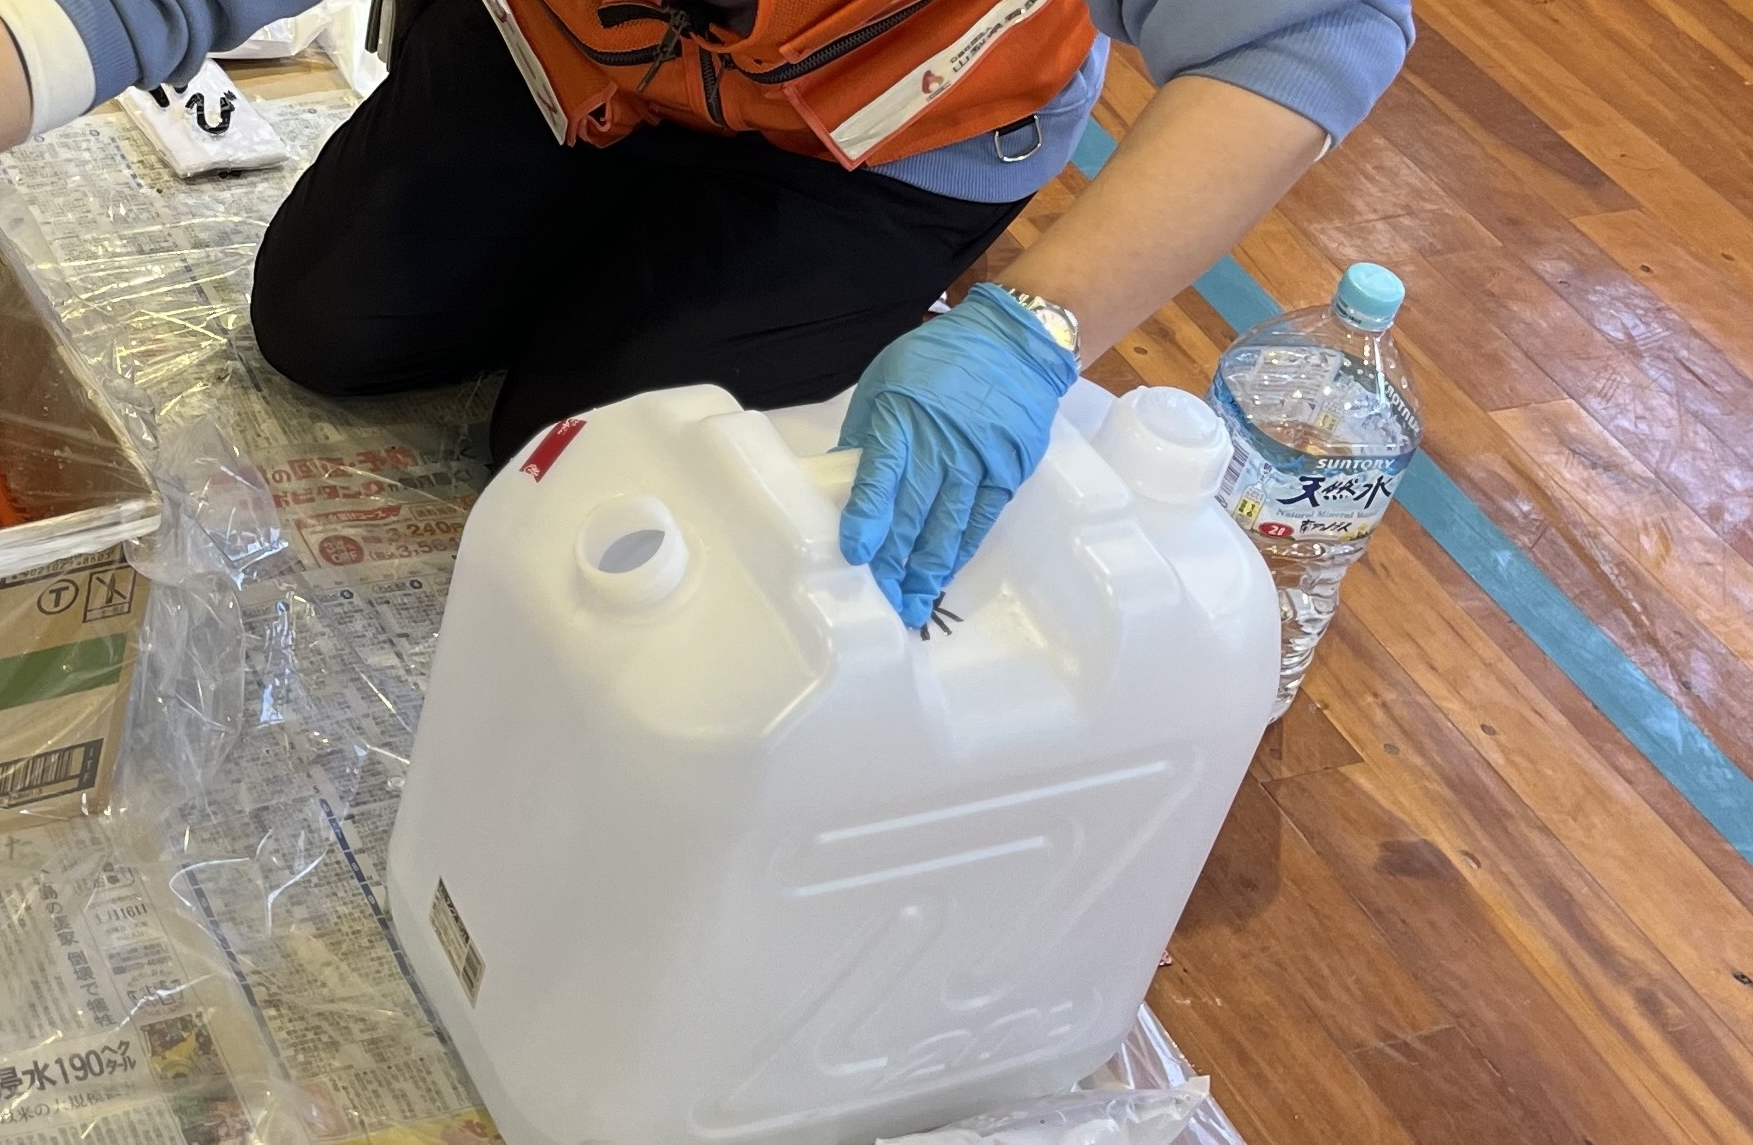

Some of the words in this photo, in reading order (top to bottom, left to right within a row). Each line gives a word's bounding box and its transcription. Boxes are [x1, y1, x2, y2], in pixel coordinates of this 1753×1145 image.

[1316, 458, 1395, 470] SUNTORY
[1276, 475, 1394, 510] 天然水
